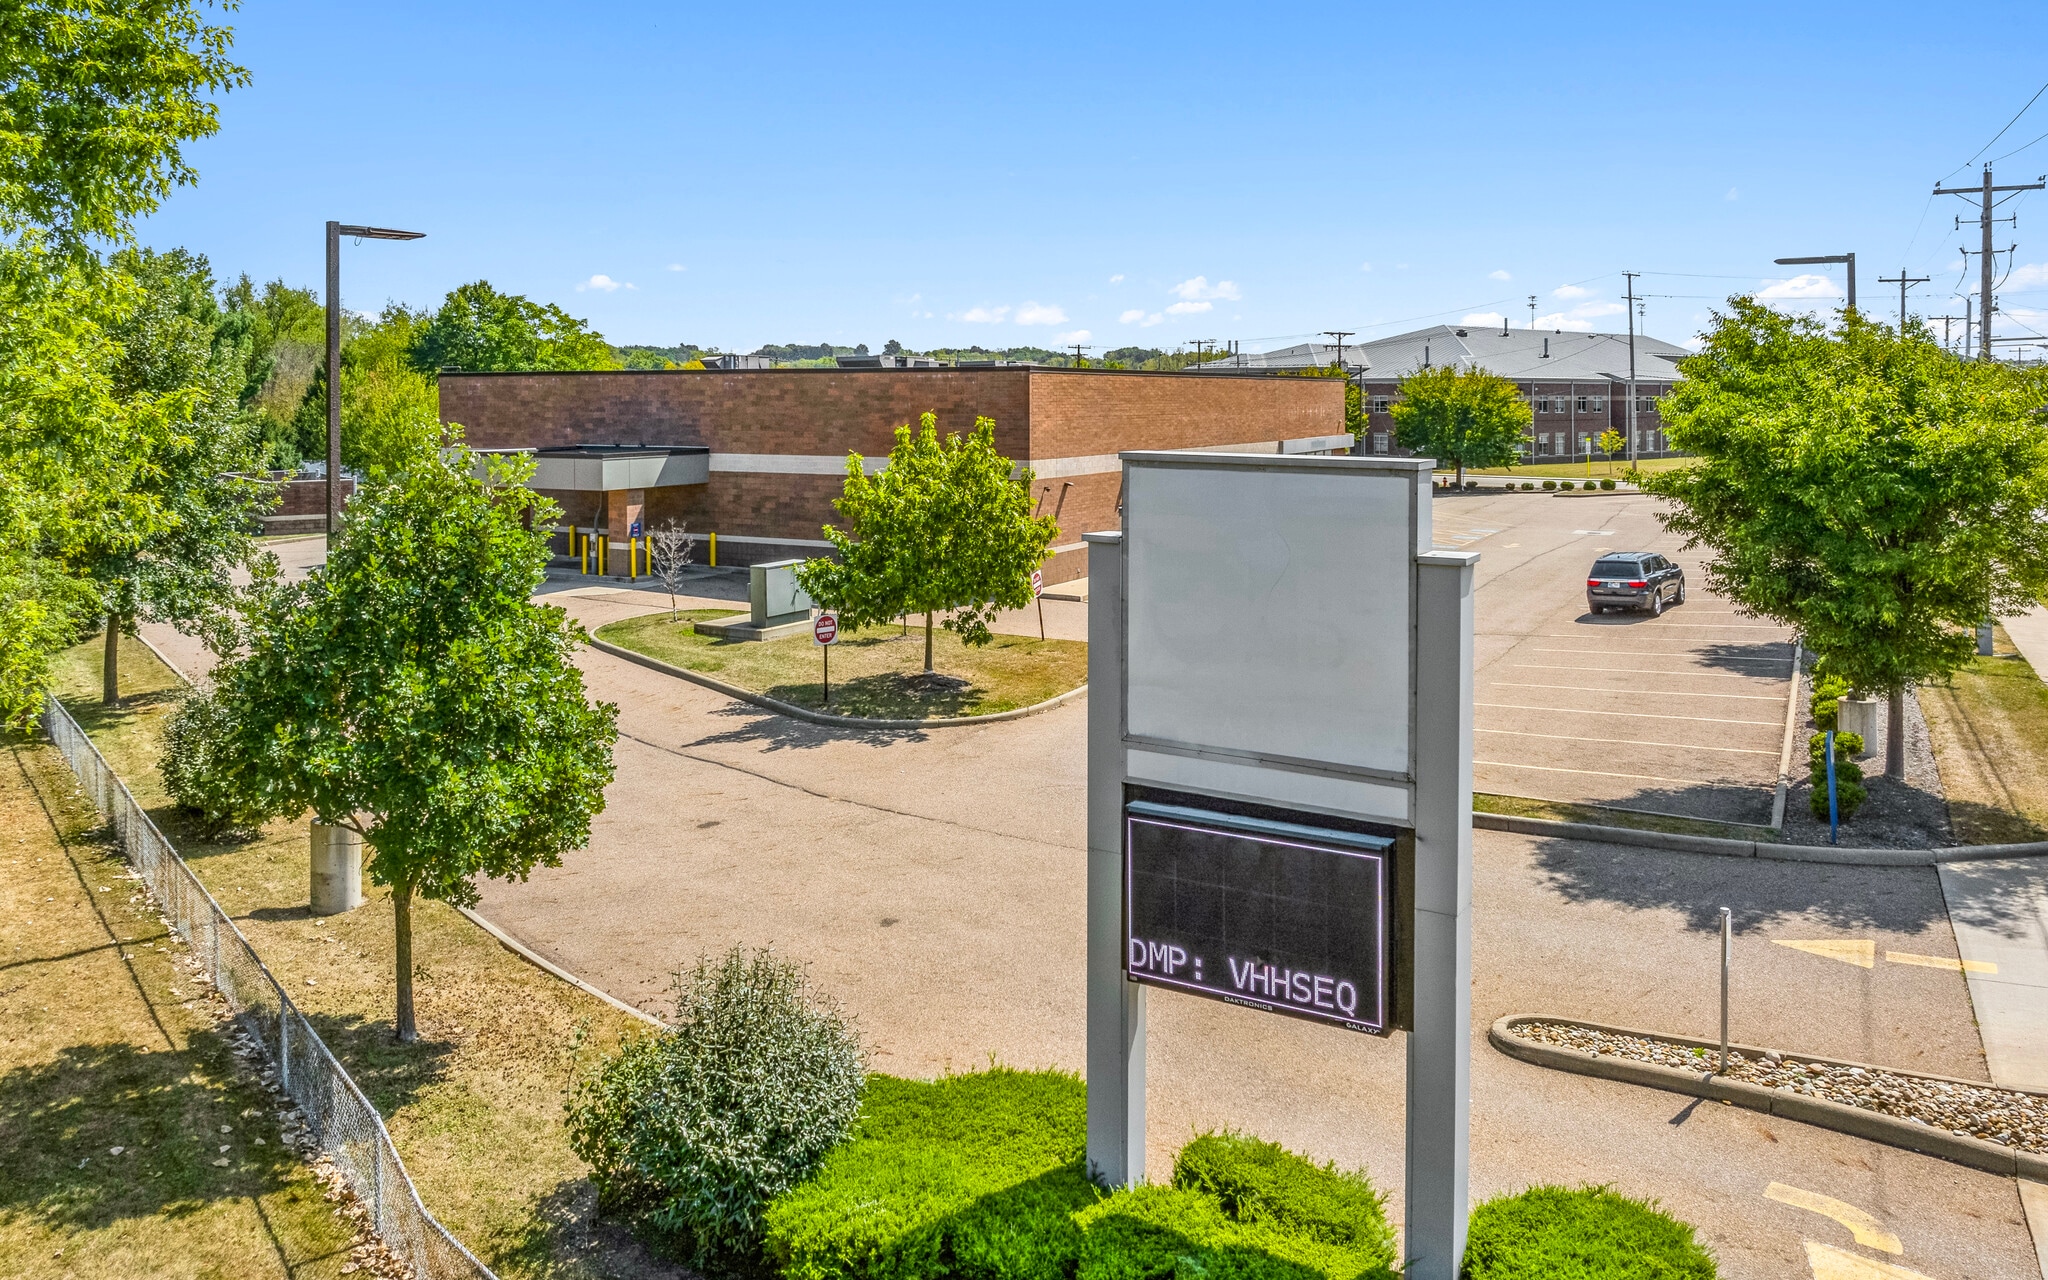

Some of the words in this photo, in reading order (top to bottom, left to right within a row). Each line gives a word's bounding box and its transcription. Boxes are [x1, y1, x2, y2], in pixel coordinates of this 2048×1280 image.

[1130, 938, 1202, 981] DMP:
[1229, 957, 1357, 1018] VHHSEQ
[1224, 996, 1273, 1012] DAKTRONICS
[1346, 1022, 1381, 1035] GALAXY
